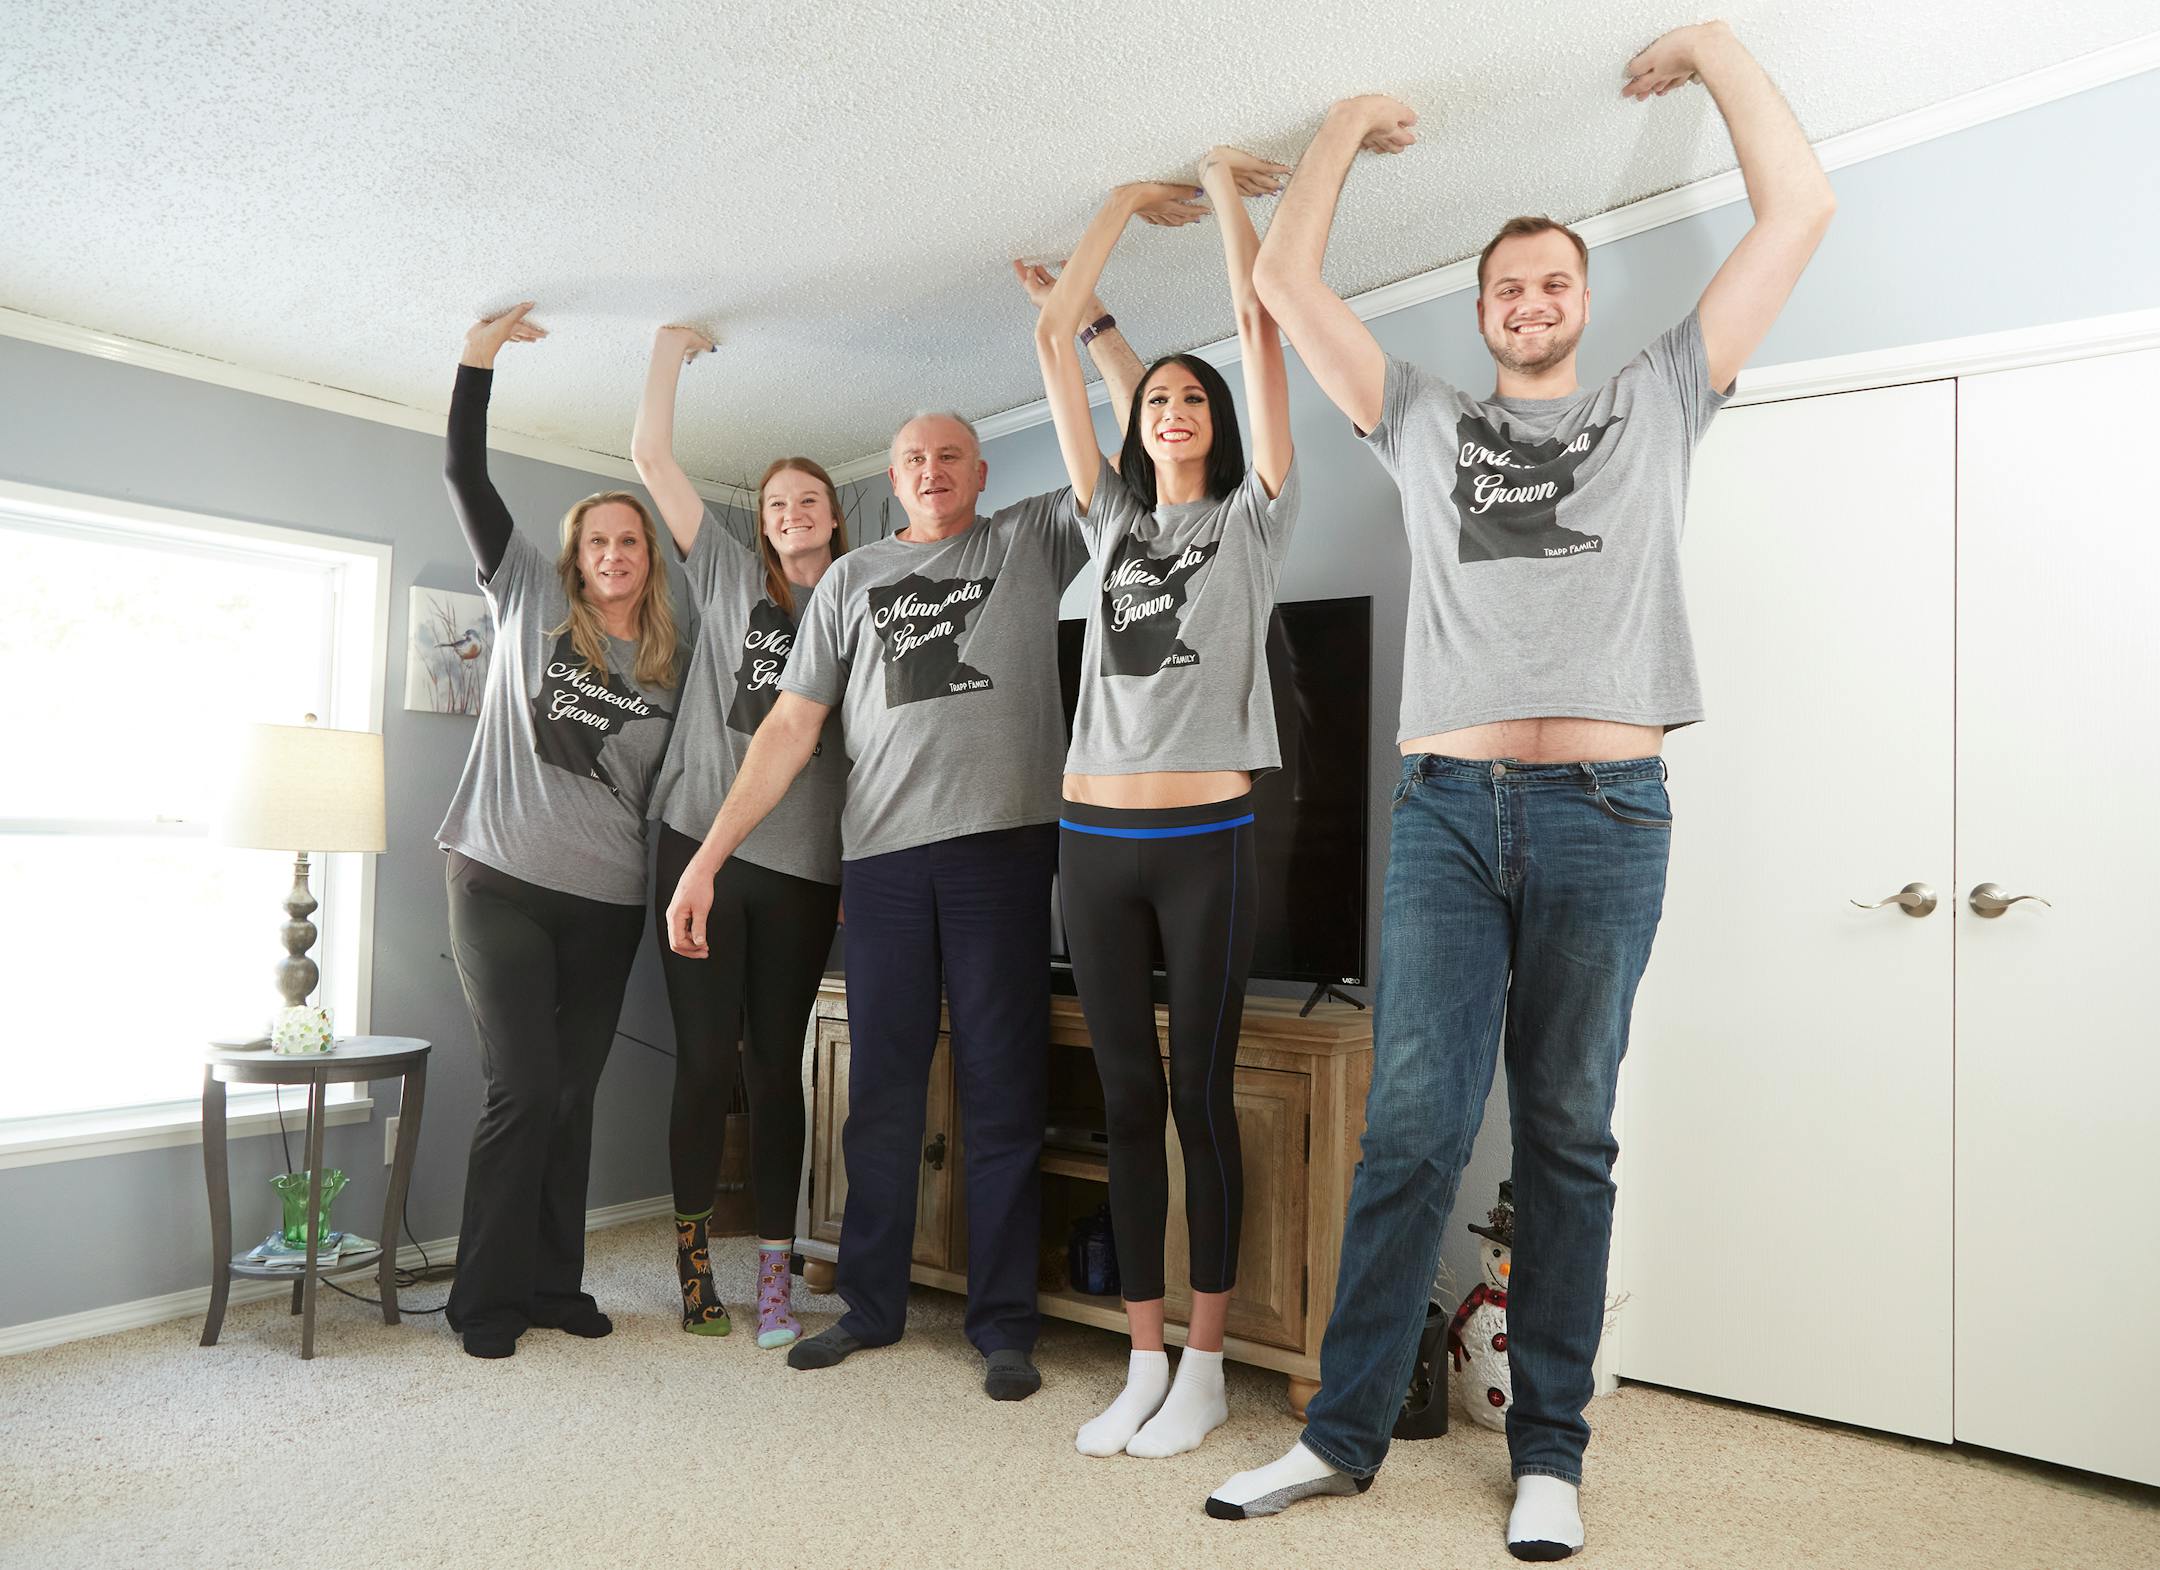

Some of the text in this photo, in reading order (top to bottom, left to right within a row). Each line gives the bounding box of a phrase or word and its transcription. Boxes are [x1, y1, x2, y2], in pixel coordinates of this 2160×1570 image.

[1469, 473, 1558, 514] Grown
[1543, 539, 1599, 557] TRAPP FAMILY
[1110, 593, 1175, 632] Grown
[546, 662, 651, 717] Minnesota
[949, 679, 989, 693] TRAPP FAMILY
[547, 689, 610, 732] Grown
